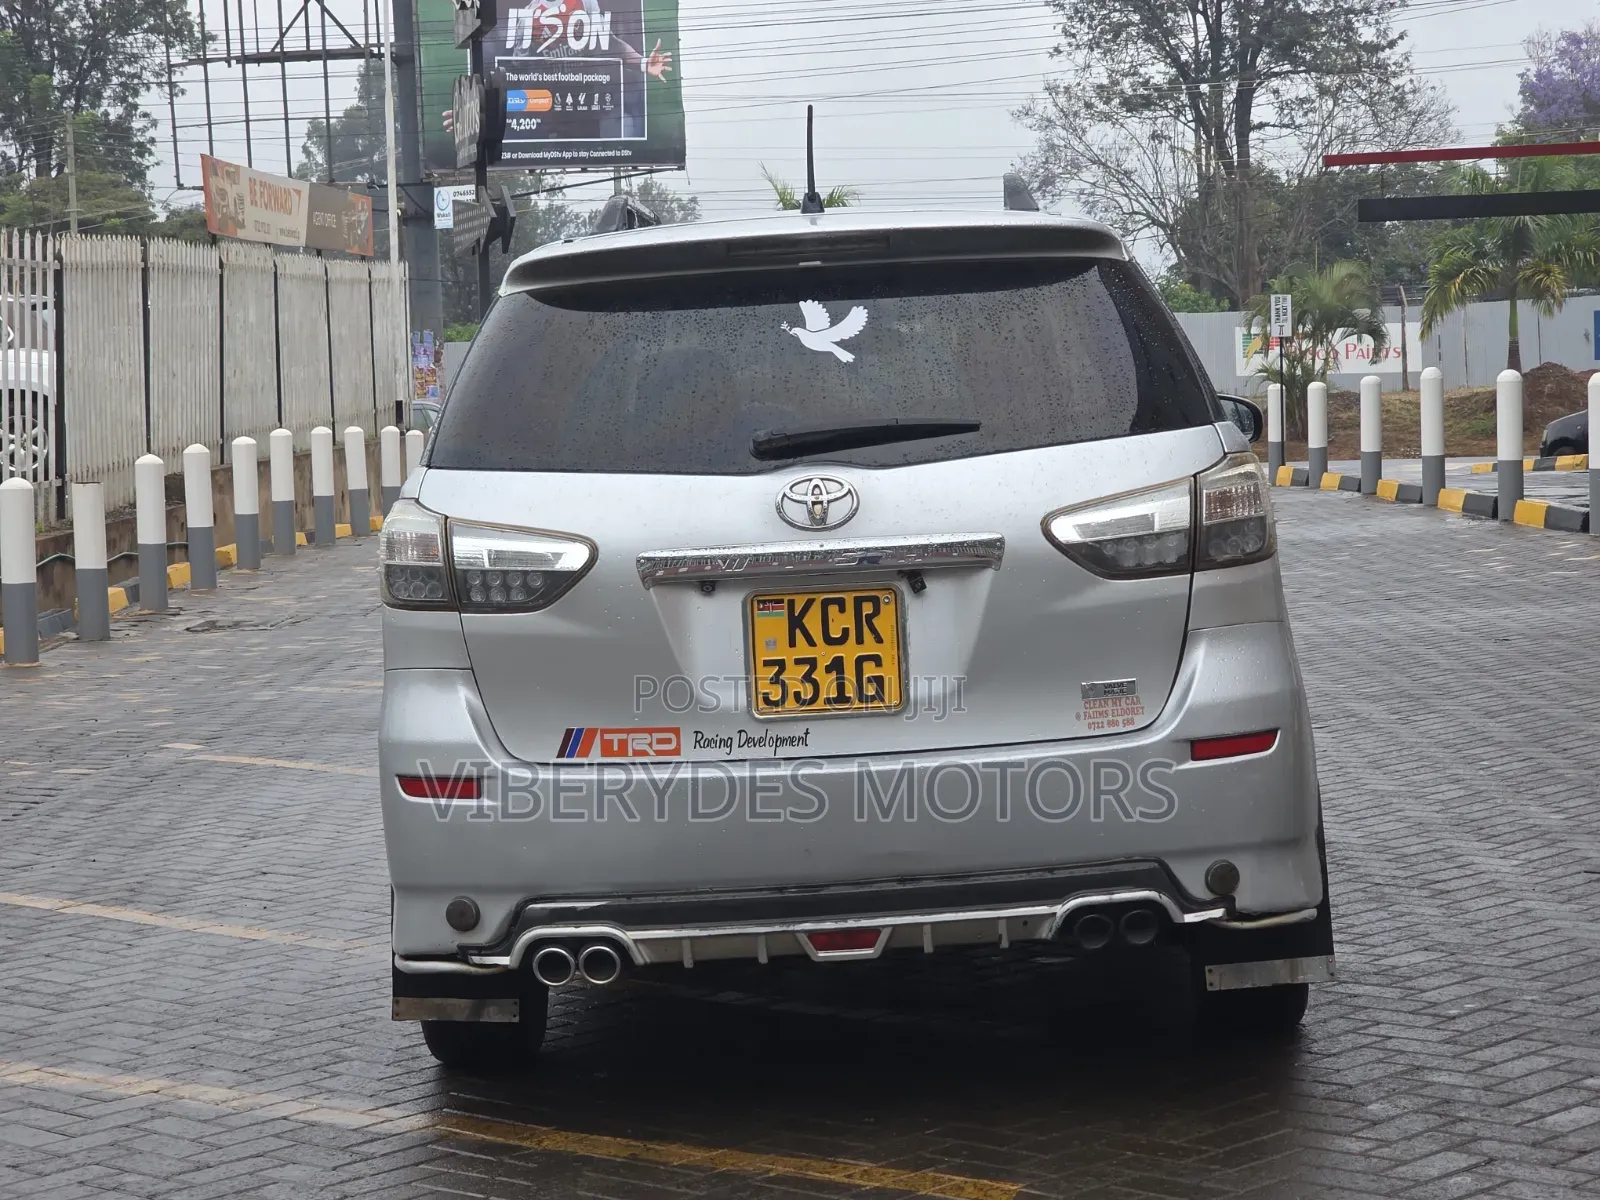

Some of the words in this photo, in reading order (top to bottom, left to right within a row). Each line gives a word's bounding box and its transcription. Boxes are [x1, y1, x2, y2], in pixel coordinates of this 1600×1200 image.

[505, 6, 563, 54] IT'S
[567, 10, 611, 51] ON
[506, 72, 518, 81] The
[519, 72, 542, 81] world's
[543, 73, 557, 81] best
[558, 73, 582, 82] football
[583, 74, 610, 84] package
[511, 118, 537, 131] 4,200
[518, 151, 542, 159] Download
[562, 151, 572, 159] App
[578, 151, 589, 159] stay
[259, 180, 293, 216] FORWARD
[787, 595, 884, 648] KCR
[761, 654, 886, 707] 331G
[1083, 699, 1109, 710] CLEAN
[1111, 697, 1122, 707] MY
[1125, 695, 1141, 706] CAR
[1111, 706, 1145, 718] ELDORET
[1087, 721, 1105, 731] 0722
[604, 732, 677, 756] TRD
[693, 730, 733, 755] Racing
[737, 727, 811, 756] Development
